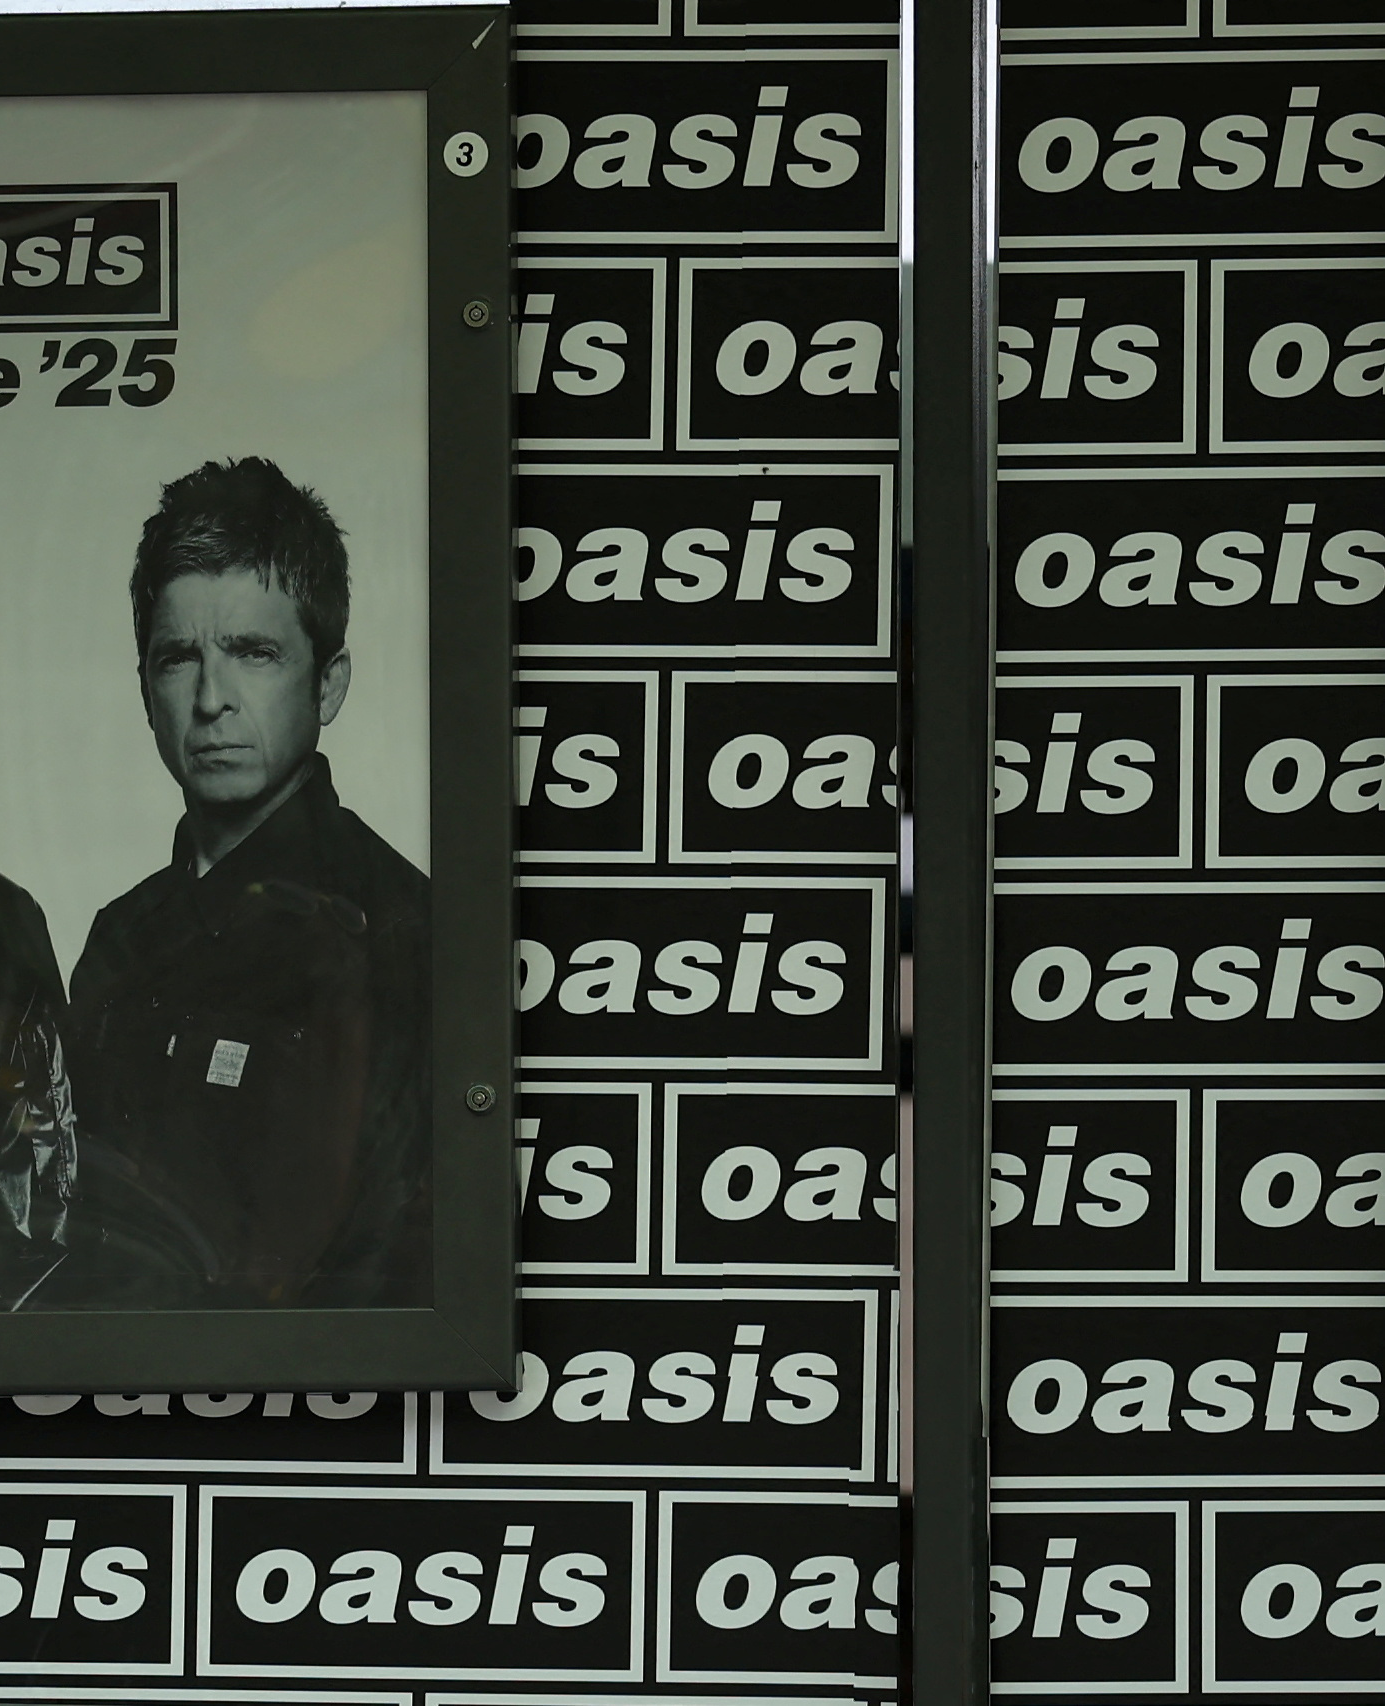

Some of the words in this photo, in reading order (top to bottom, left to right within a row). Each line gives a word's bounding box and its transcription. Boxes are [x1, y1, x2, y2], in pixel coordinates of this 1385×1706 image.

[456, 142, 473, 167] 3
[515, 86, 862, 189] oasis
[1019, 87, 1385, 192] oasis
[39, 338, 178, 407] '25
[716, 321, 900, 396] oa
[1015, 504, 1385, 608] oasis
[708, 734, 898, 809] oa
[1011, 919, 1385, 1021] oasis
[702, 1146, 896, 1222] oa
[1007, 1333, 1382, 1434] oasis
[236, 1526, 607, 1628] oasis
